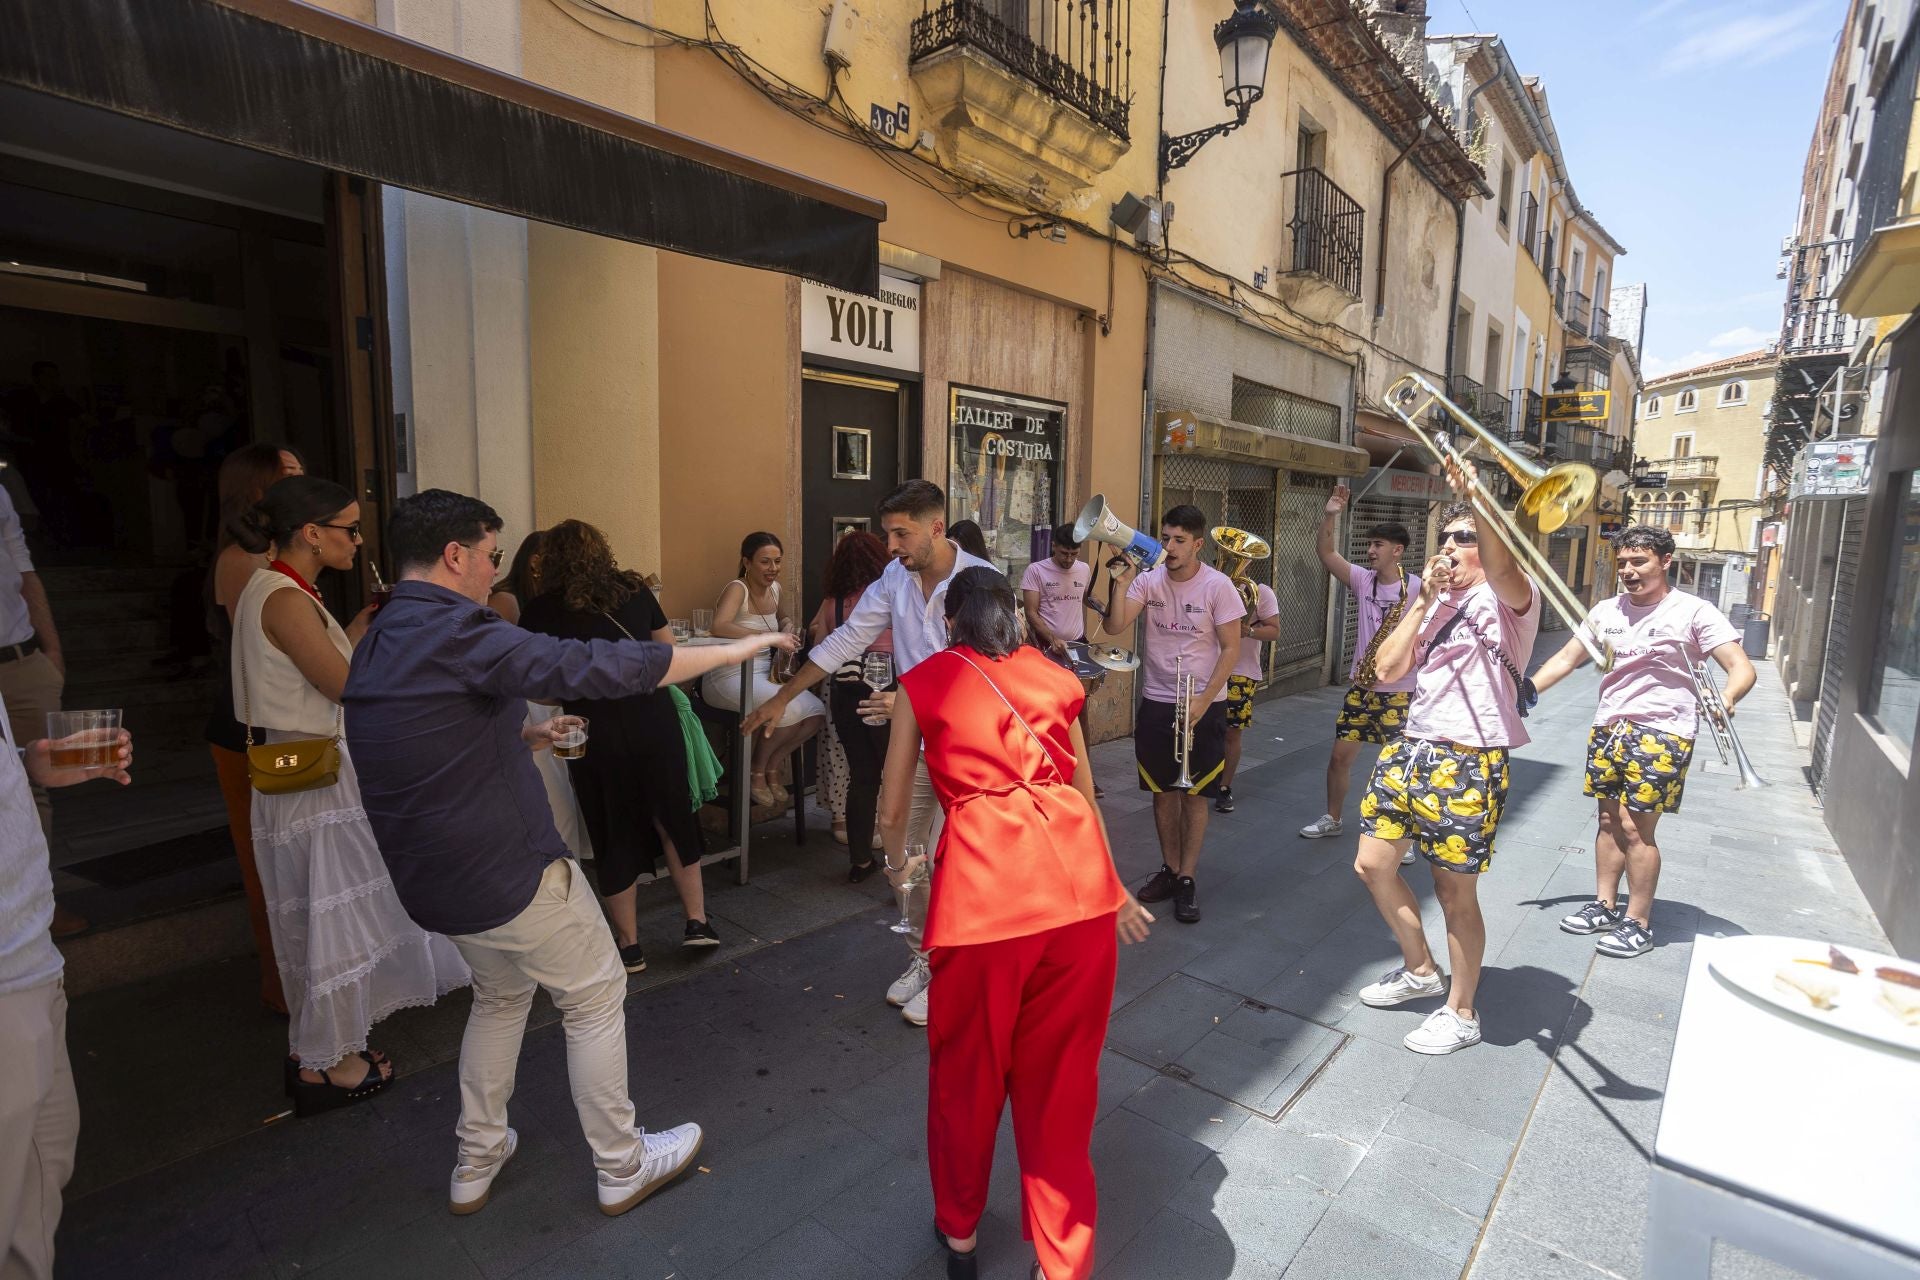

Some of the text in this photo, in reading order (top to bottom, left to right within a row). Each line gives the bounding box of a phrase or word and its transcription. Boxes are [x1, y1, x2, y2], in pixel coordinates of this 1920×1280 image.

[875, 288, 917, 311] RREGLOS
[826, 295, 894, 353] YOLI
[956, 405, 1046, 435] TALLER DE
[986, 437, 1053, 461] COSTURA
[1154, 621, 1197, 631] VALKIRIA
